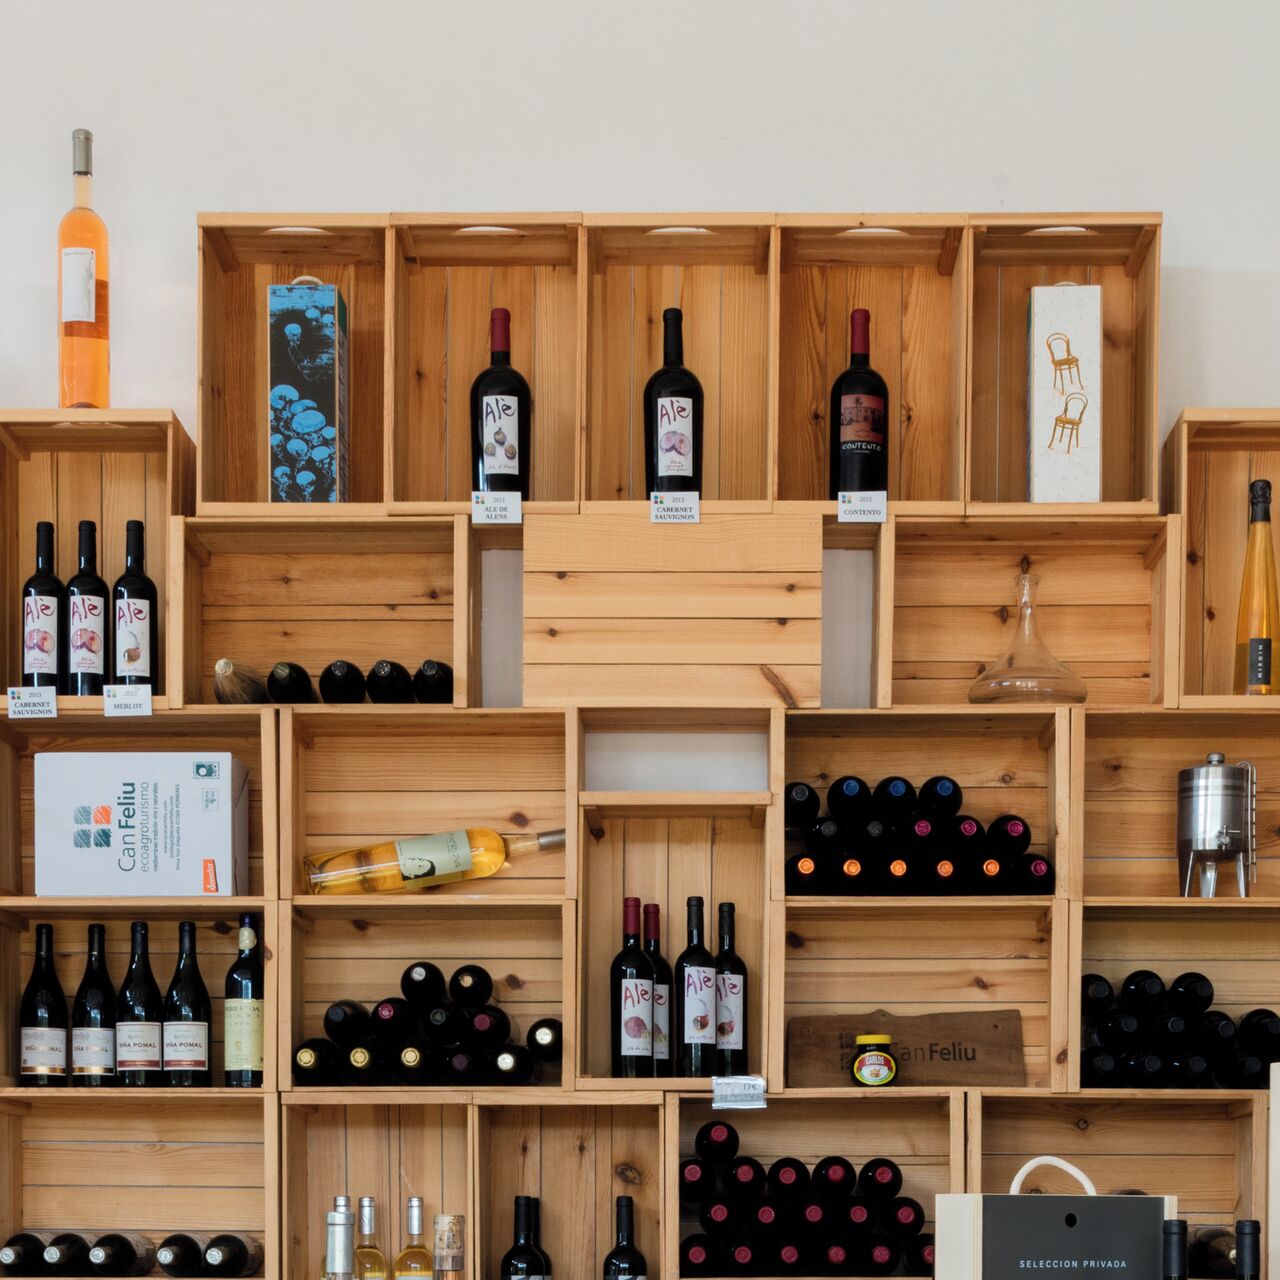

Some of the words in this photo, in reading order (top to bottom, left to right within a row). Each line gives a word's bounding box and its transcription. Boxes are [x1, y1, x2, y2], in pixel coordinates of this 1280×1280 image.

[841, 443, 882, 451] CONTENTO
[844, 508, 882, 516] CONTENTO
[14, 701, 51, 709] CABERNET
[113, 702, 143, 711] MERLOT
[12, 709, 53, 717] SAUVIGNON
[117, 782, 136, 830] Feliu
[140, 782, 152, 872] ecoagroturismo
[118, 834, 136, 872] Can
[206, 863, 217, 892] demeter
[930, 1043, 977, 1060] Feliu
[865, 1055, 886, 1064] CARLOS
[1019, 1259, 1079, 1270] SELECCION
[1082, 1259, 1128, 1269] PRIVADA
